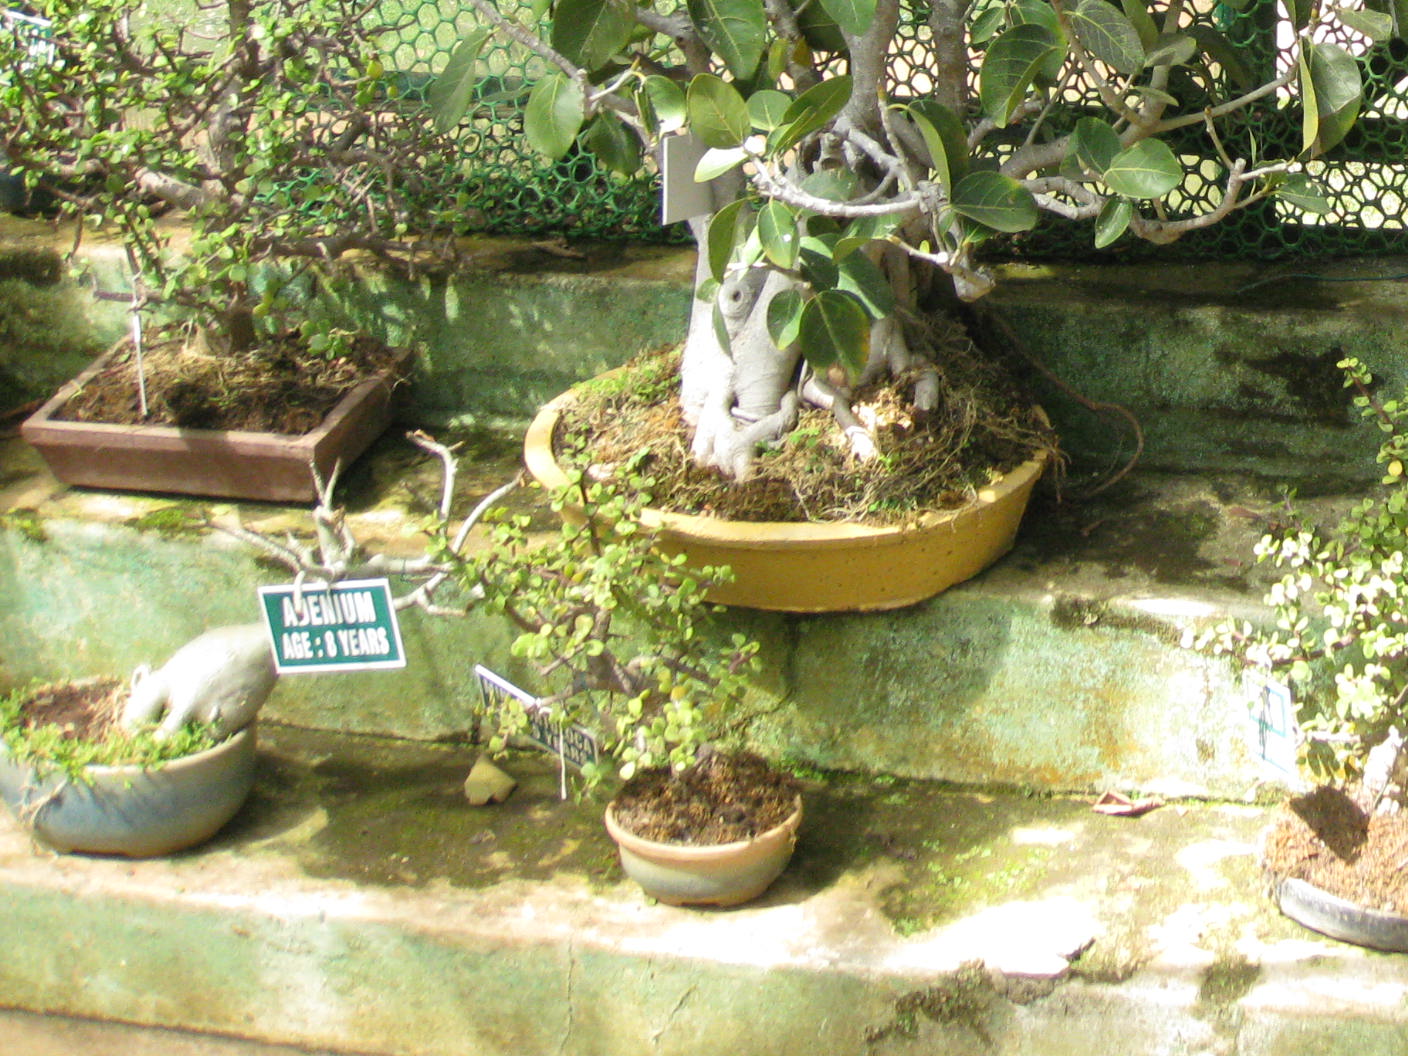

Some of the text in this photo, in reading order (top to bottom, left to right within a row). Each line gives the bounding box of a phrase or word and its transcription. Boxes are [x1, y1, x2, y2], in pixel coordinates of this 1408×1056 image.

[282, 631, 314, 659] AGE
[324, 629, 338, 657] 8
[337, 626, 390, 657] YEARS
